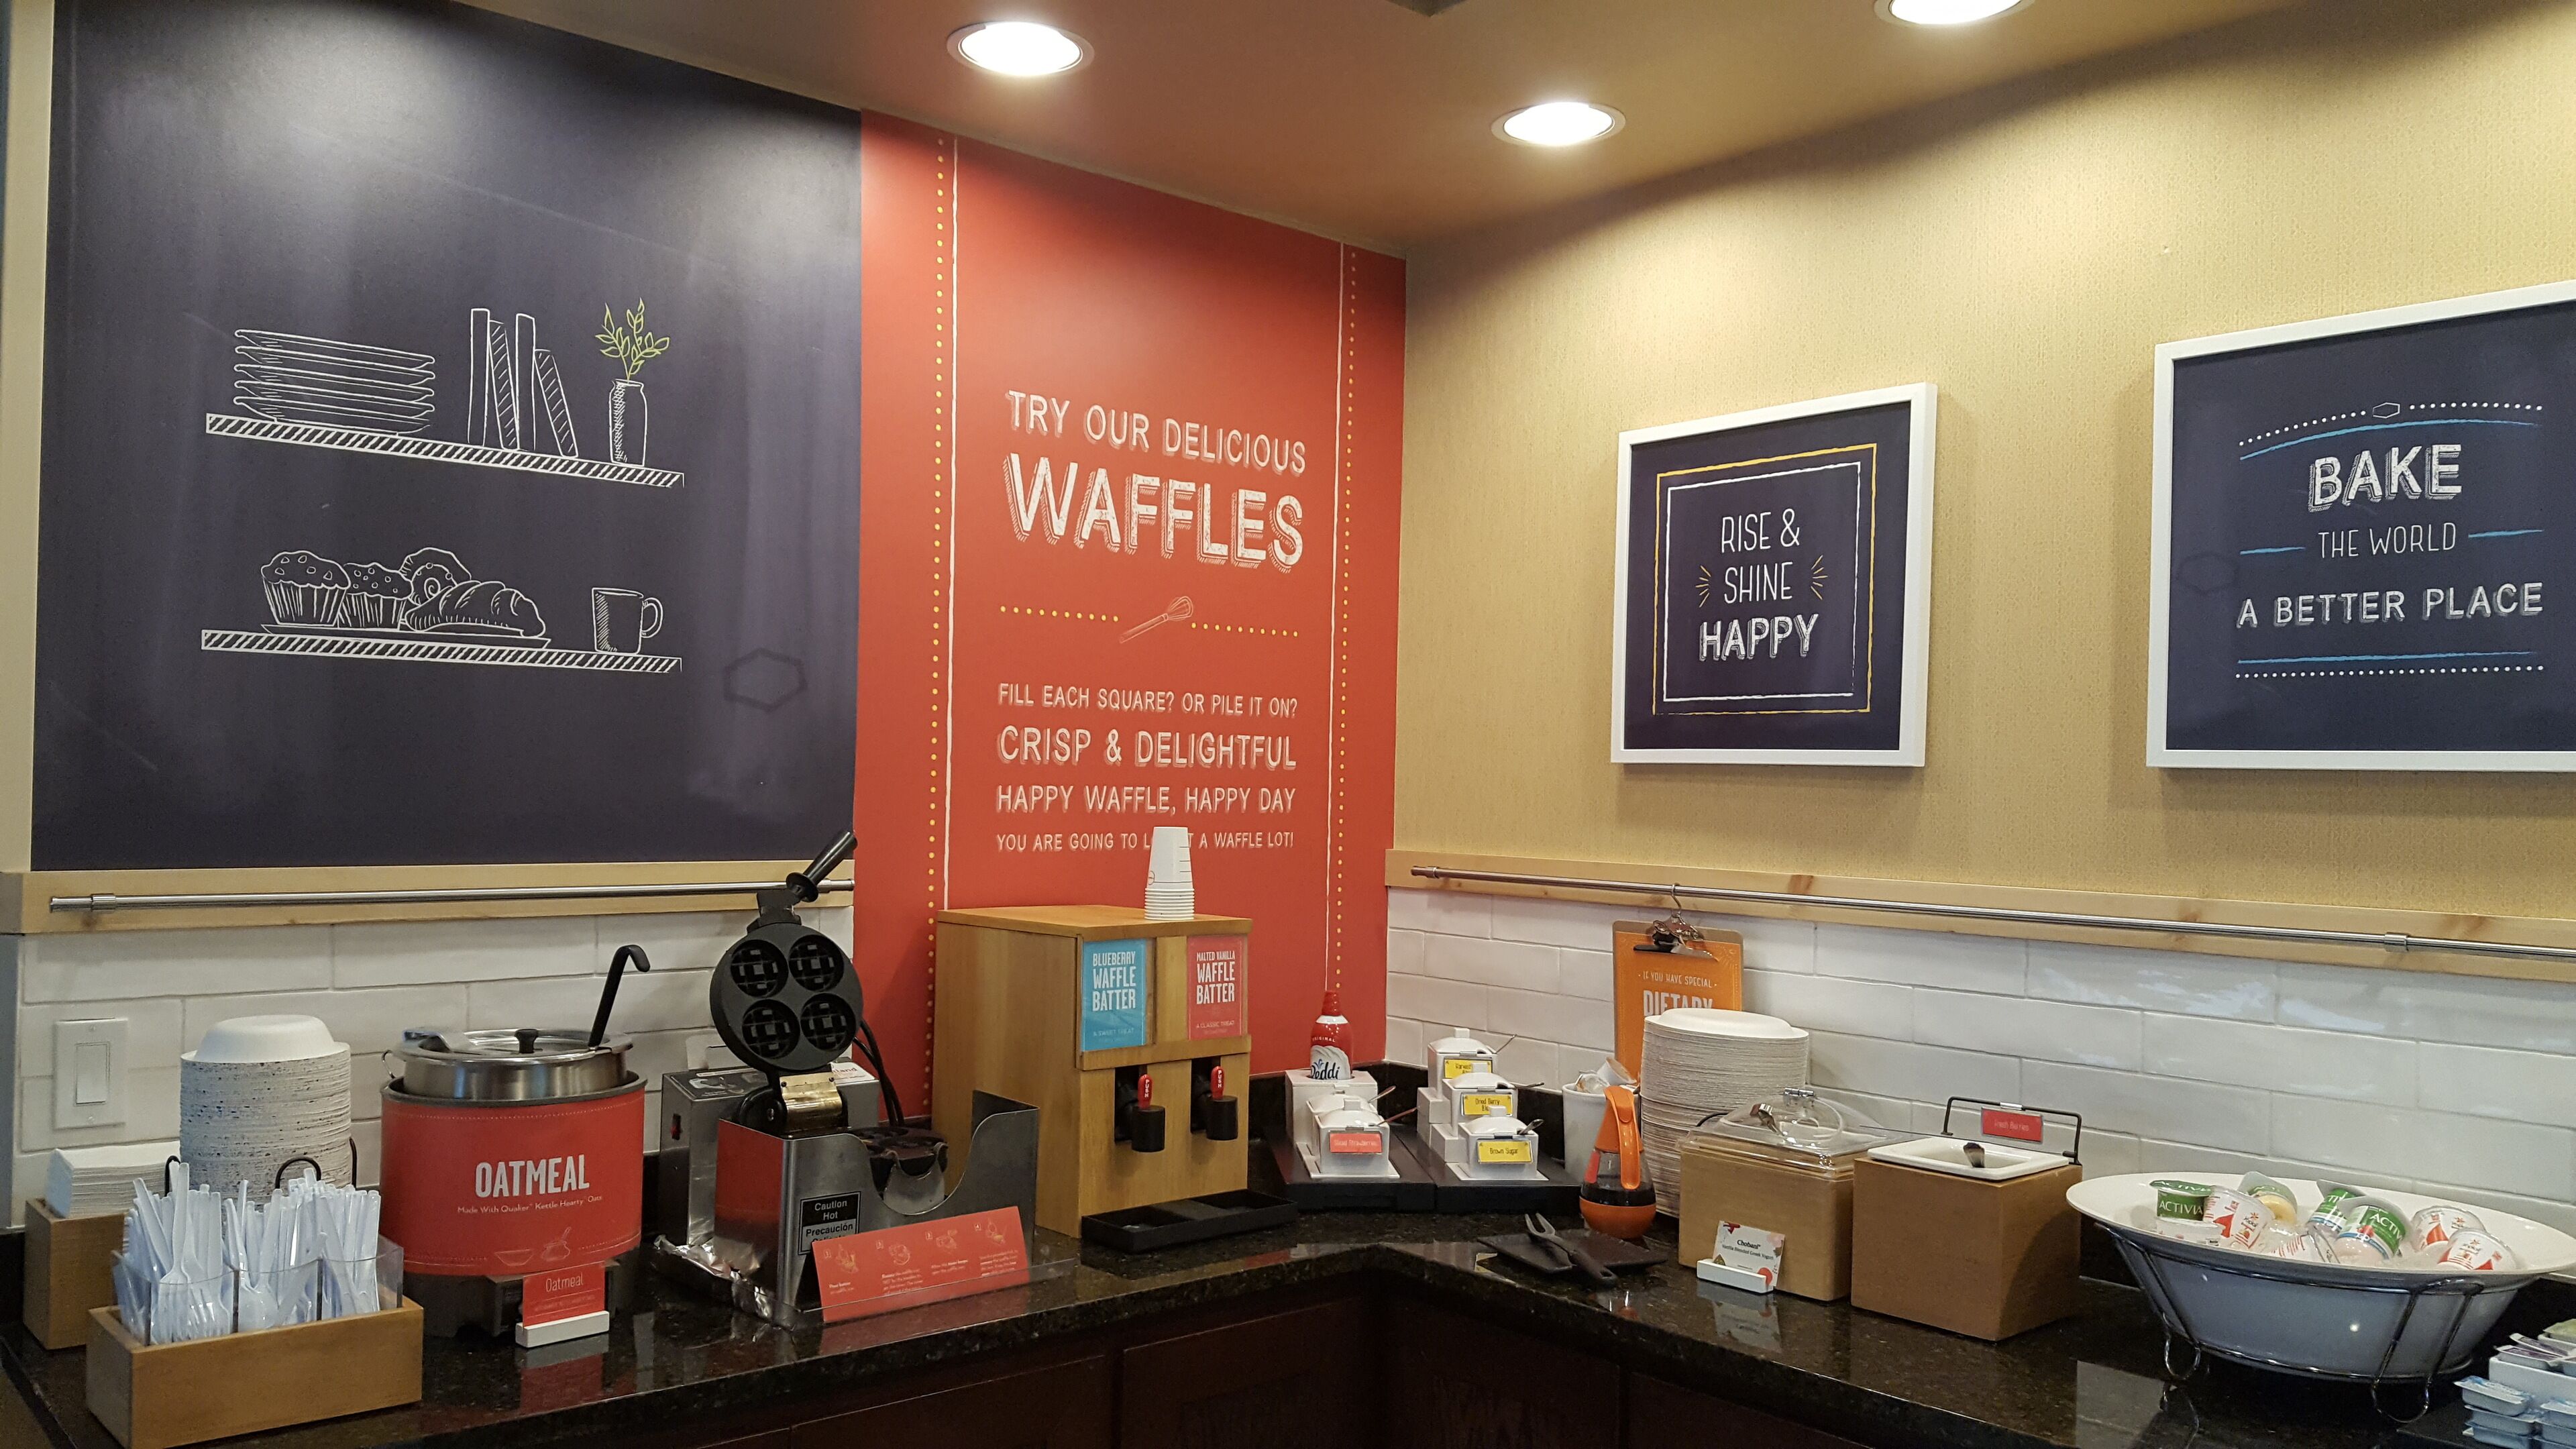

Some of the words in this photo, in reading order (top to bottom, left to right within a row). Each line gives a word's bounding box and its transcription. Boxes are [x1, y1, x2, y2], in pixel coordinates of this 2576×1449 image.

[1006, 390, 1070, 437] TRY
[1084, 404, 1150, 451] OUR
[1163, 418, 1307, 476] DELICIOUS
[2308, 443, 2462, 513] BAKE
[1003, 453, 1303, 574] WAFFLES
[1721, 511, 1772, 553] RISE
[1780, 508, 1801, 548] &
[2318, 530, 2359, 559] THE
[2369, 522, 2457, 555] WORLD
[1723, 561, 1793, 604] SHINE
[2236, 598, 2258, 629] A
[2273, 590, 2406, 627] BETTER
[2422, 582, 2544, 620] PLACE
[1699, 613, 1819, 662] HAPPY
[998, 683, 1035, 706] FILL
[1042, 685, 1090, 708] EACH
[1097, 688, 1175, 713] SQUARE?
[1181, 692, 1205, 715] OR
[1211, 695, 1244, 716] PILE
[1249, 696, 1263, 718] IT
[1269, 697, 1299, 719] ON?
[998, 725, 1092, 765] CRISP
[1106, 729, 1123, 764] &
[1134, 731, 1298, 771] DELIGHTFUL
[996, 785, 1074, 814] HAPPY
[1084, 786, 1177, 816] WAFFLE,
[1185, 787, 1252, 814] HAPPY
[1260, 788, 1297, 814] DAY
[997, 833, 1027, 853] YOU
[1032, 834, 1063, 852] ARE
[1070, 833, 1115, 851] GOING
[1120, 833, 1138, 850] TO
[1198, 832, 1209, 849] A
[1214, 832, 1264, 849] WAFFLE
[1267, 831, 1295, 848] LOT!
[1092, 951, 1136, 967] BLUEBERRY
[1196, 951, 1216, 961] MALTED
[1216, 950, 1236, 960] VANILLA
[1093, 965, 1136, 989] WAFFLE
[1197, 961, 1236, 983] WAFFLE
[1643, 971, 1650, 980] IF
[1651, 972, 1664, 982] YOU
[1666, 973, 1682, 985] HAVE
[1684, 976, 1713, 989] SPECIAL
[1092, 987, 1136, 1012] BATTER
[1196, 982, 1235, 1005] BATTER
[1505, 1148, 1519, 1156] Sugar
[474, 1154, 590, 1198] OATMEAL
[480, 1205, 499, 1214] With
[535, 1201, 558, 1210] Kettle
[559, 1199, 584, 1208] Hearty
[814, 1200, 848, 1212] Caution
[823, 1211, 839, 1221] Hot
[2159, 1199, 2204, 1216] ACTIVIA
[806, 1223, 854, 1237] Precaución
[545, 1272, 584, 1293] Oatmeal
